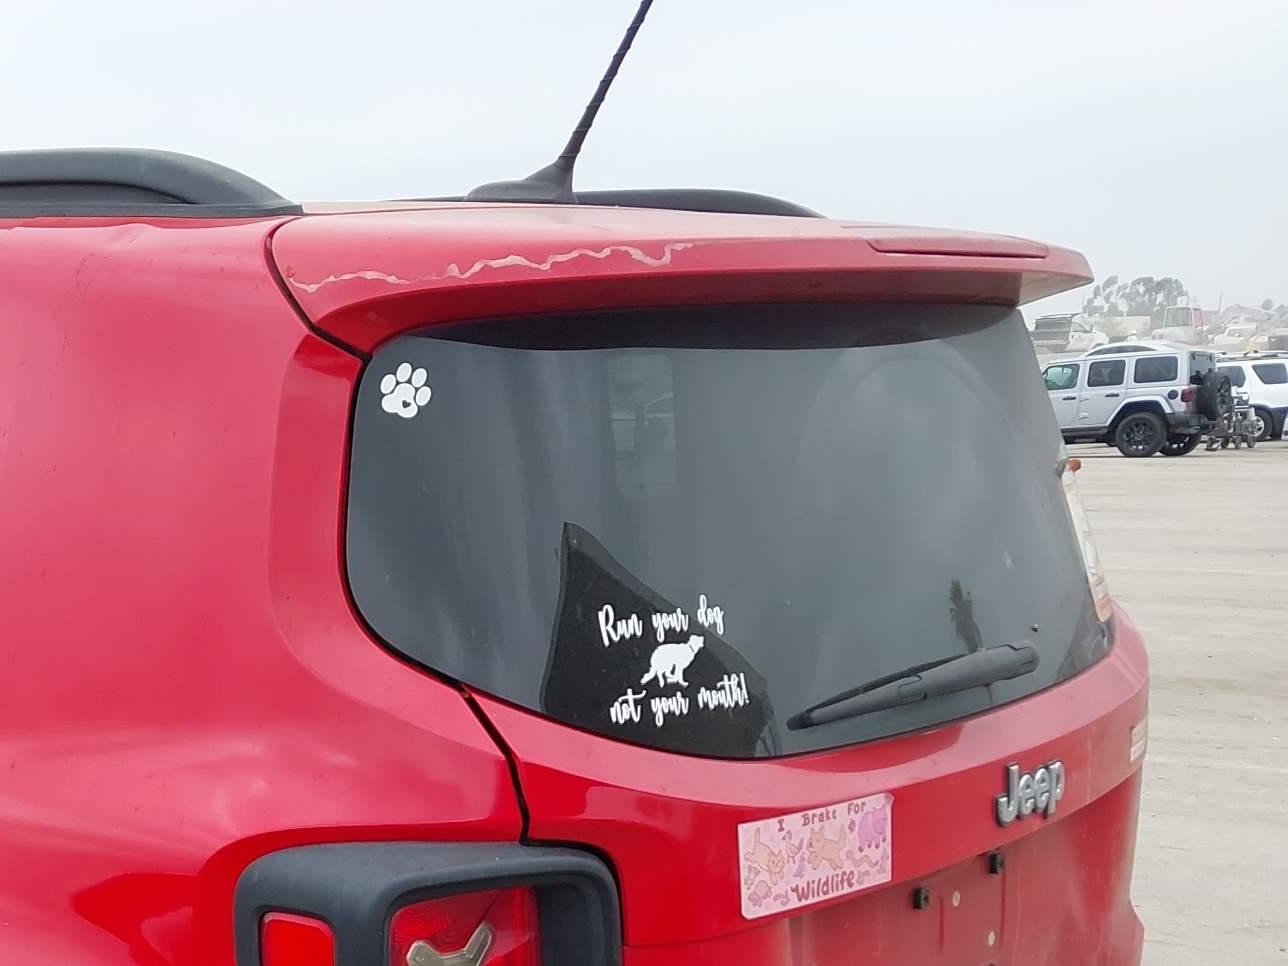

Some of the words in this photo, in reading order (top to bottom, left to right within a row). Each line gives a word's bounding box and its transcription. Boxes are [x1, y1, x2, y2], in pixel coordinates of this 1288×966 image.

[598, 604, 643, 648] Run
[651, 607, 689, 642] your
[697, 593, 724, 636] dog
[609, 688, 647, 726] not
[650, 691, 690, 728] your
[697, 672, 751, 711] mouth!
[994, 760, 1066, 828] Jeep
[777, 818, 785, 833] I
[790, 869, 856, 903] Wildlife
